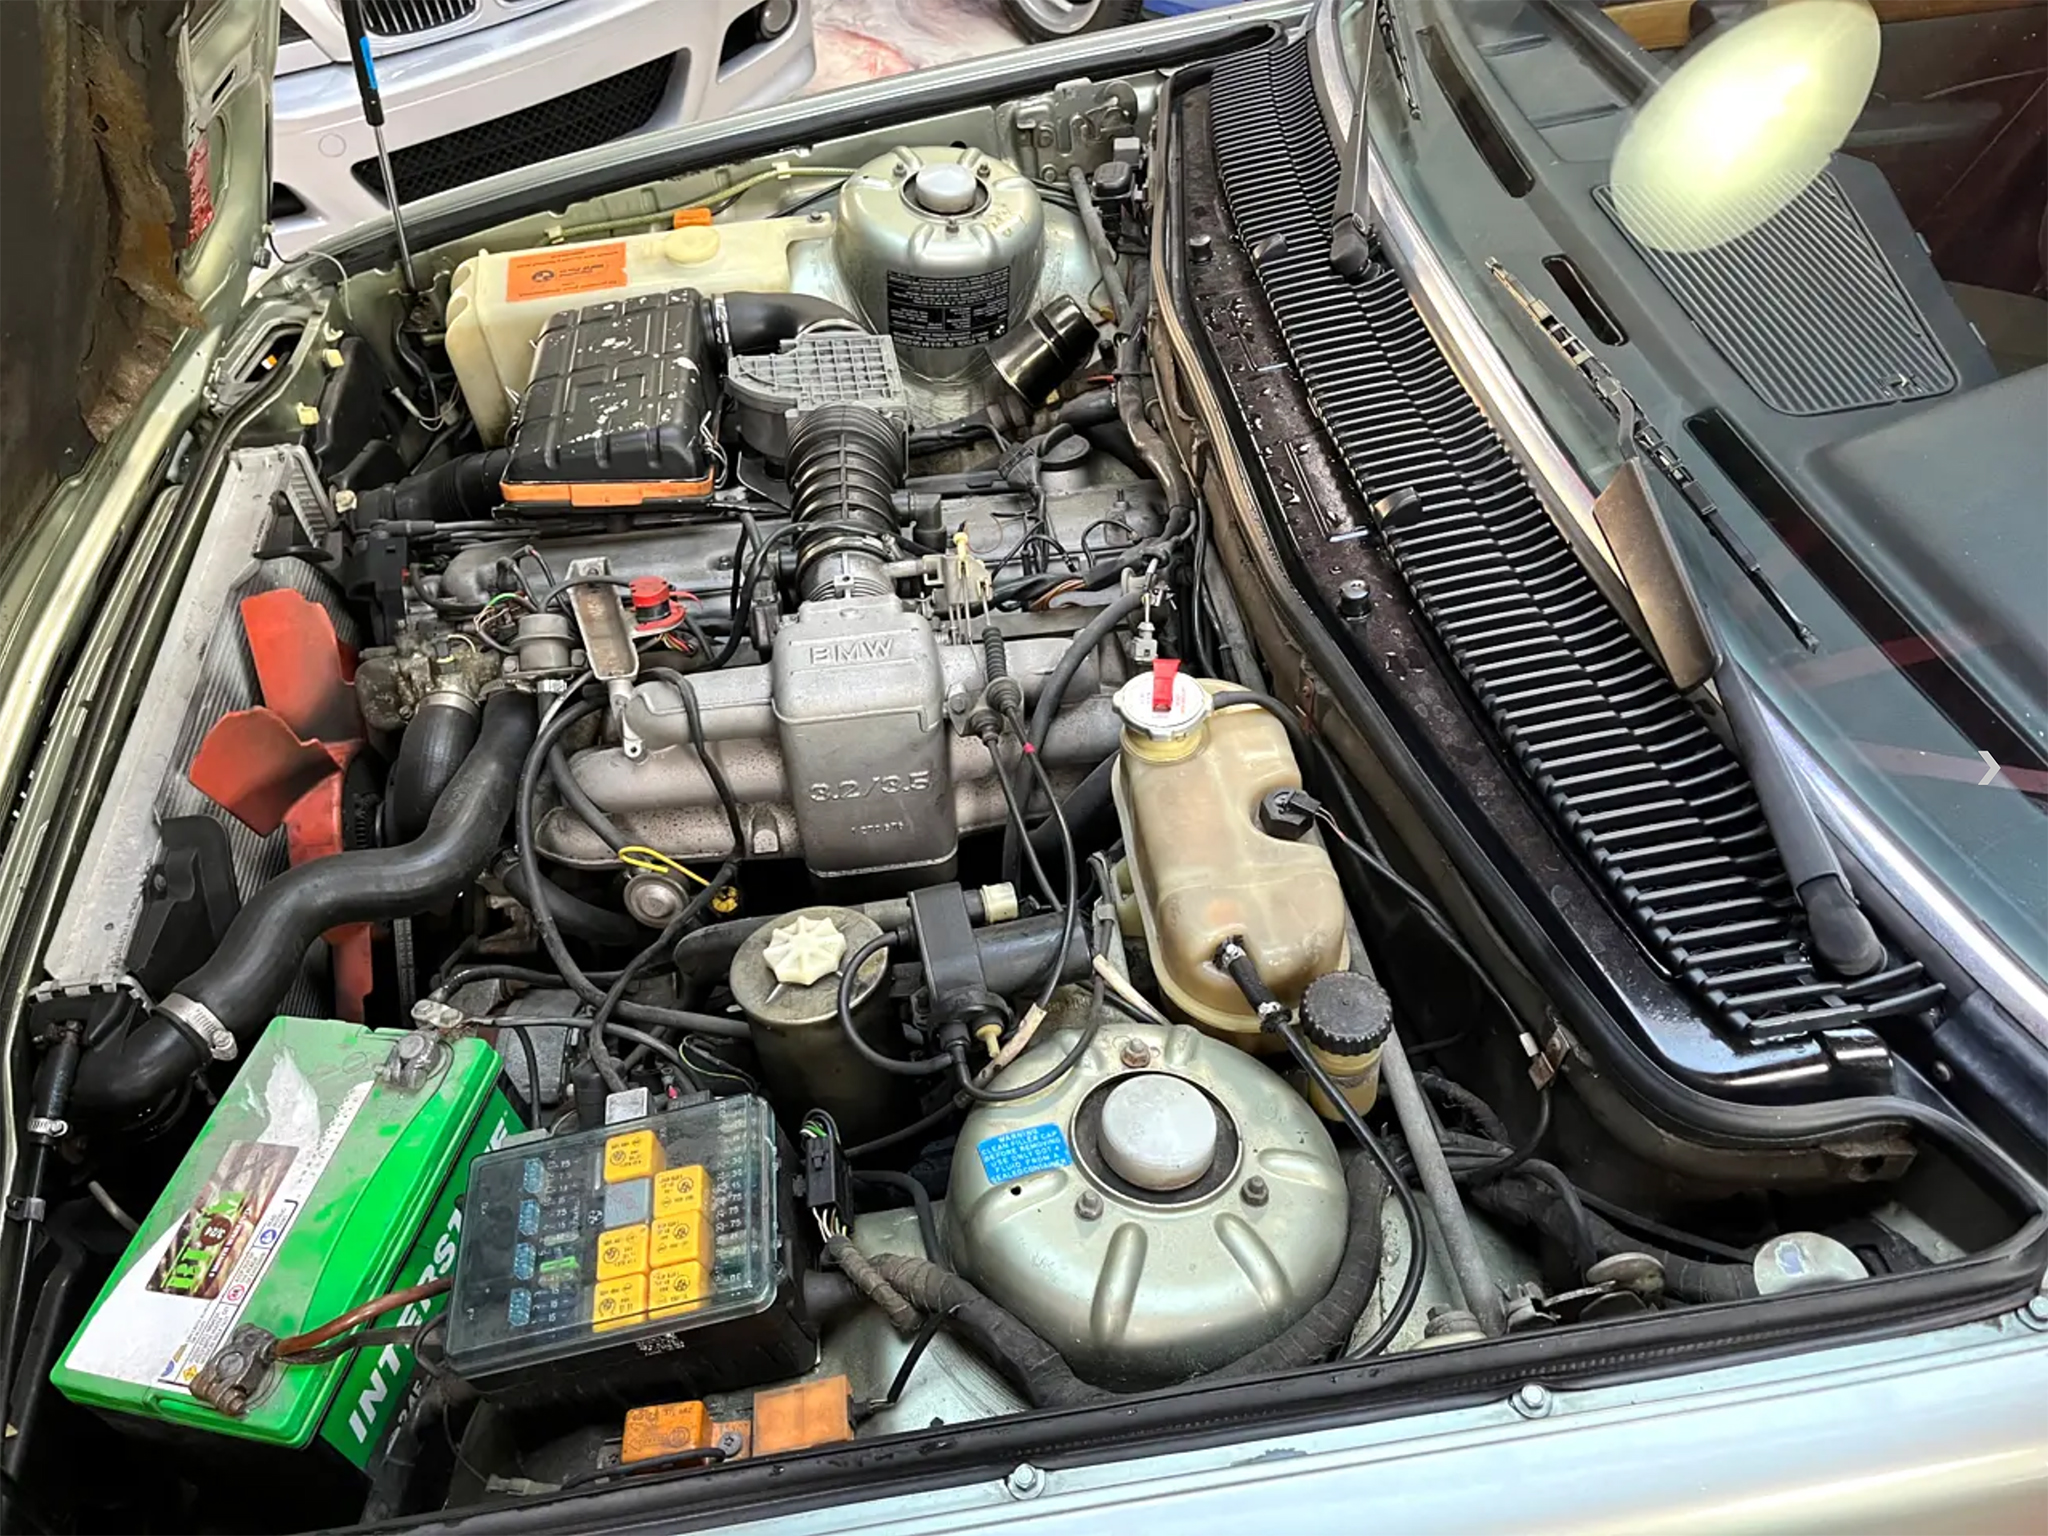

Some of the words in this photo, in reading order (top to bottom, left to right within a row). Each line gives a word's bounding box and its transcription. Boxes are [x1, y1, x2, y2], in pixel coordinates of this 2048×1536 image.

[809, 638, 894, 664] BMW
[809, 770, 930, 801] 3.2/3.5
[981, 1142, 1009, 1156] CLEAN
[1010, 1134, 1039, 1148] FILLER
[1040, 1130, 1058, 1140] CAP
[998, 1128, 1038, 1142] WARNING
[984, 1147, 1018, 1163] BEFORE
[1019, 1136, 1061, 1152] REMOVING
[991, 1157, 1008, 1168] USE
[1010, 1151, 1033, 1162] ONLY
[1034, 1146, 1052, 1156] DOT
[995, 1161, 1021, 1173] FLUID
[1025, 1154, 1050, 1166] FROM
[349, 1115, 508, 1444] INTERSTE
